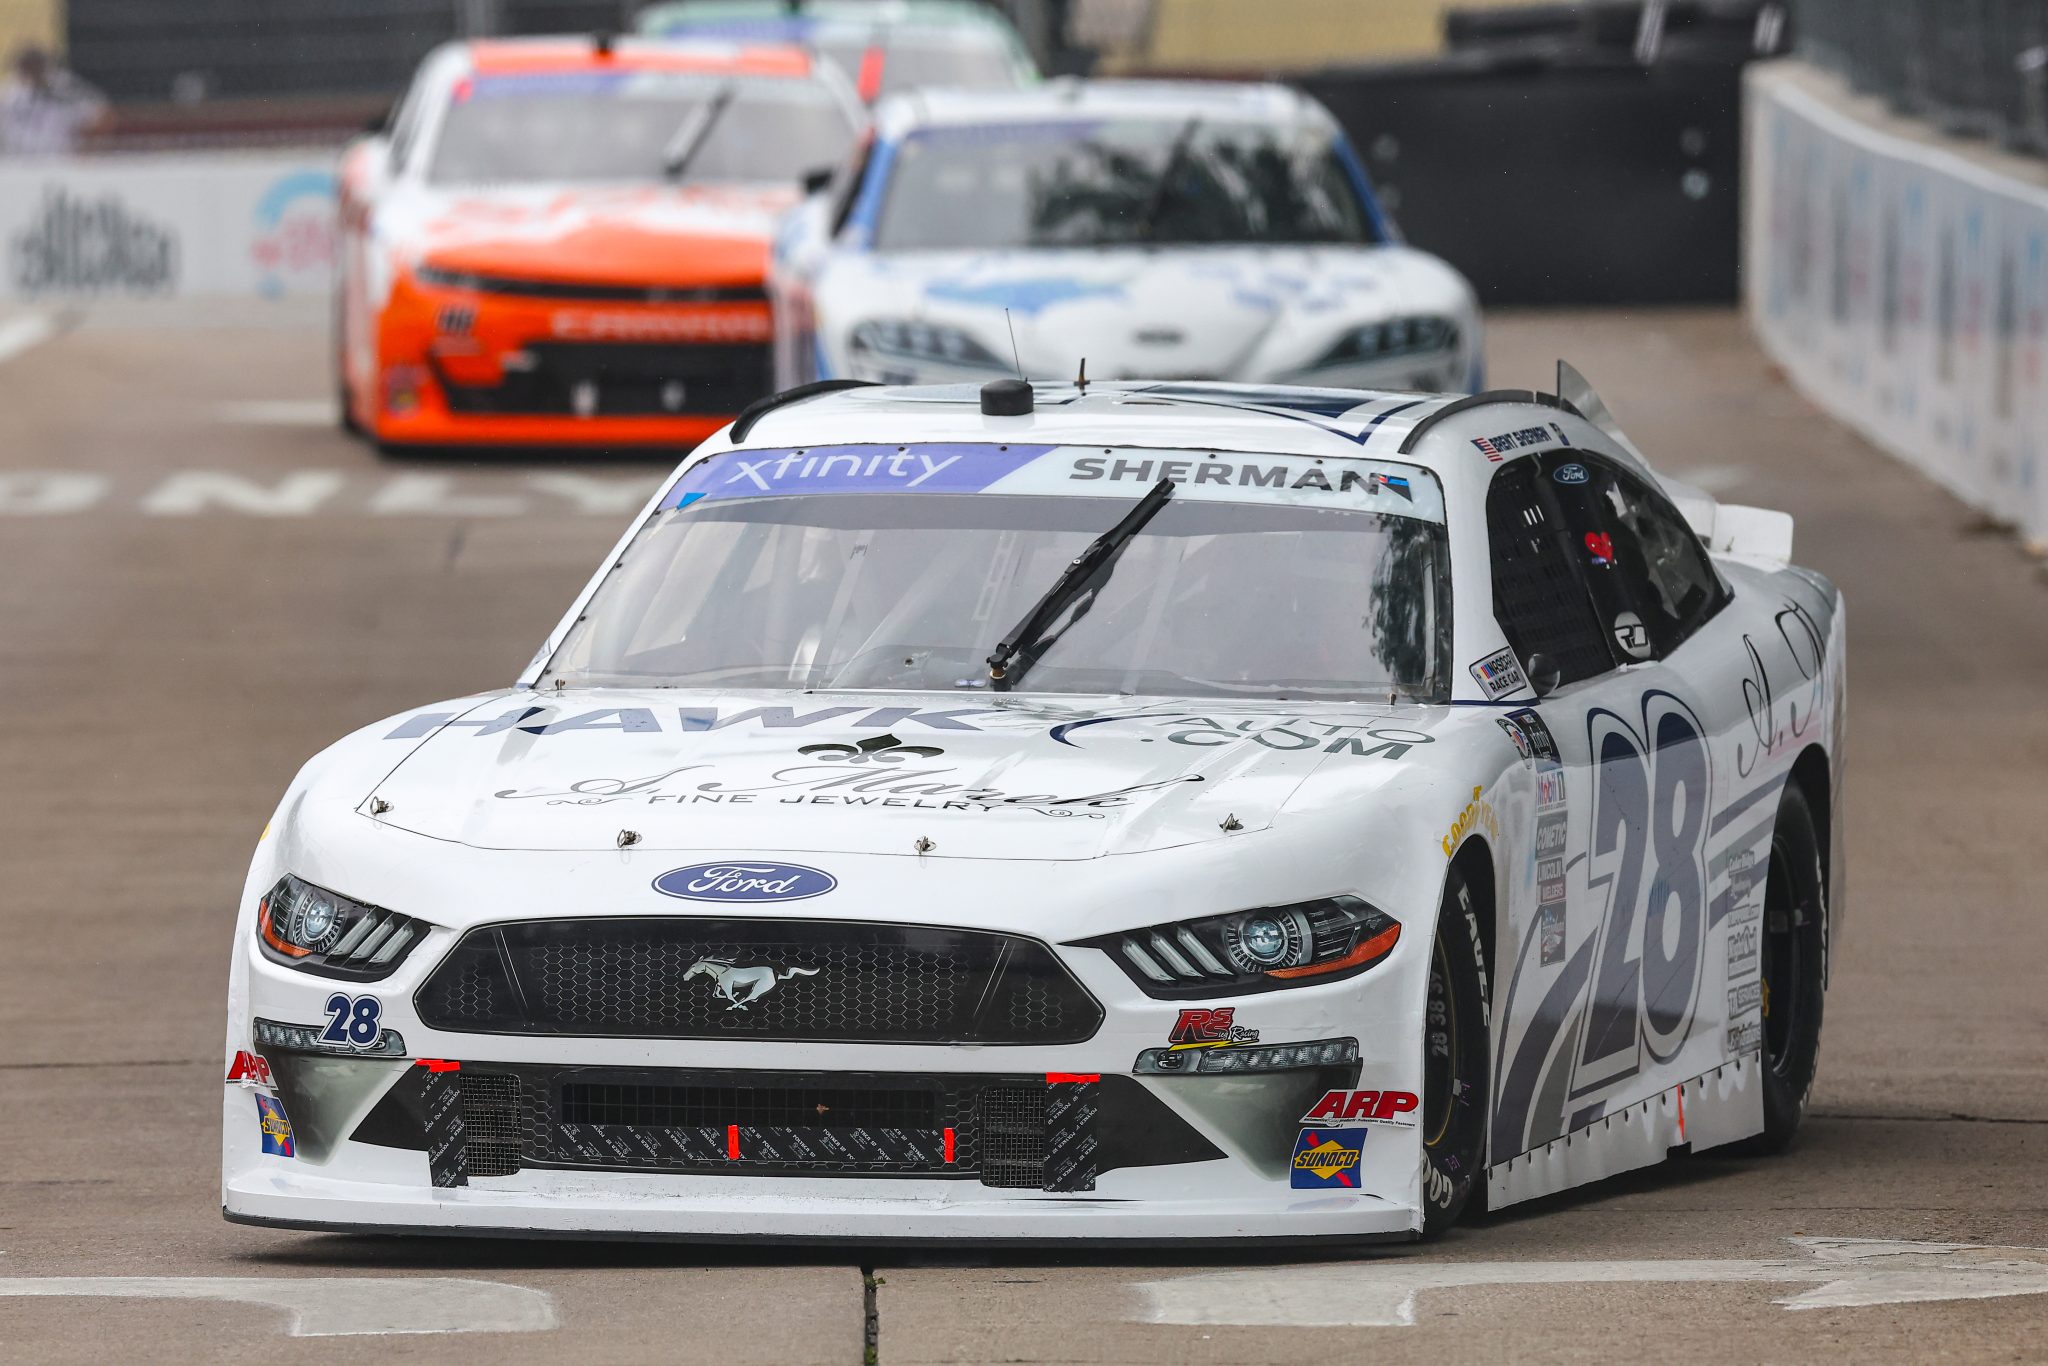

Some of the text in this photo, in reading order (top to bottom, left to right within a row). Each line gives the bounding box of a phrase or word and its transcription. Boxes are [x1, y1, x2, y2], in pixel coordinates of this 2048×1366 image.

[724, 448, 963, 490] xfinity
[1069, 457, 1383, 496] SHERMAN
[1563, 467, 1584, 481] Ford
[1488, 654, 1513, 677] NASCAR
[1489, 671, 1520, 694] RACE CAR
[382, 707, 1004, 741] HAWK
[1153, 716, 1436, 743] AUTO
[1537, 772, 1557, 806] Mobil
[648, 794, 1003, 812] FINE JEWELRY
[1537, 821, 1567, 850] COMETIC
[687, 866, 802, 894] Ford
[1539, 861, 1562, 882] LINCOLN
[1569, 689, 1713, 1102] 28
[316, 992, 382, 1049] 28
[1429, 1001, 1447, 1026] 38
[1231, 1026, 1260, 1041] Racing
[1431, 1032, 1449, 1057] 28
[227, 1051, 270, 1084] ARP
[1307, 1090, 1420, 1119] ARP
[265, 1117, 289, 1135] SUNOCO
[1296, 1151, 1357, 1167] SUNOCO
